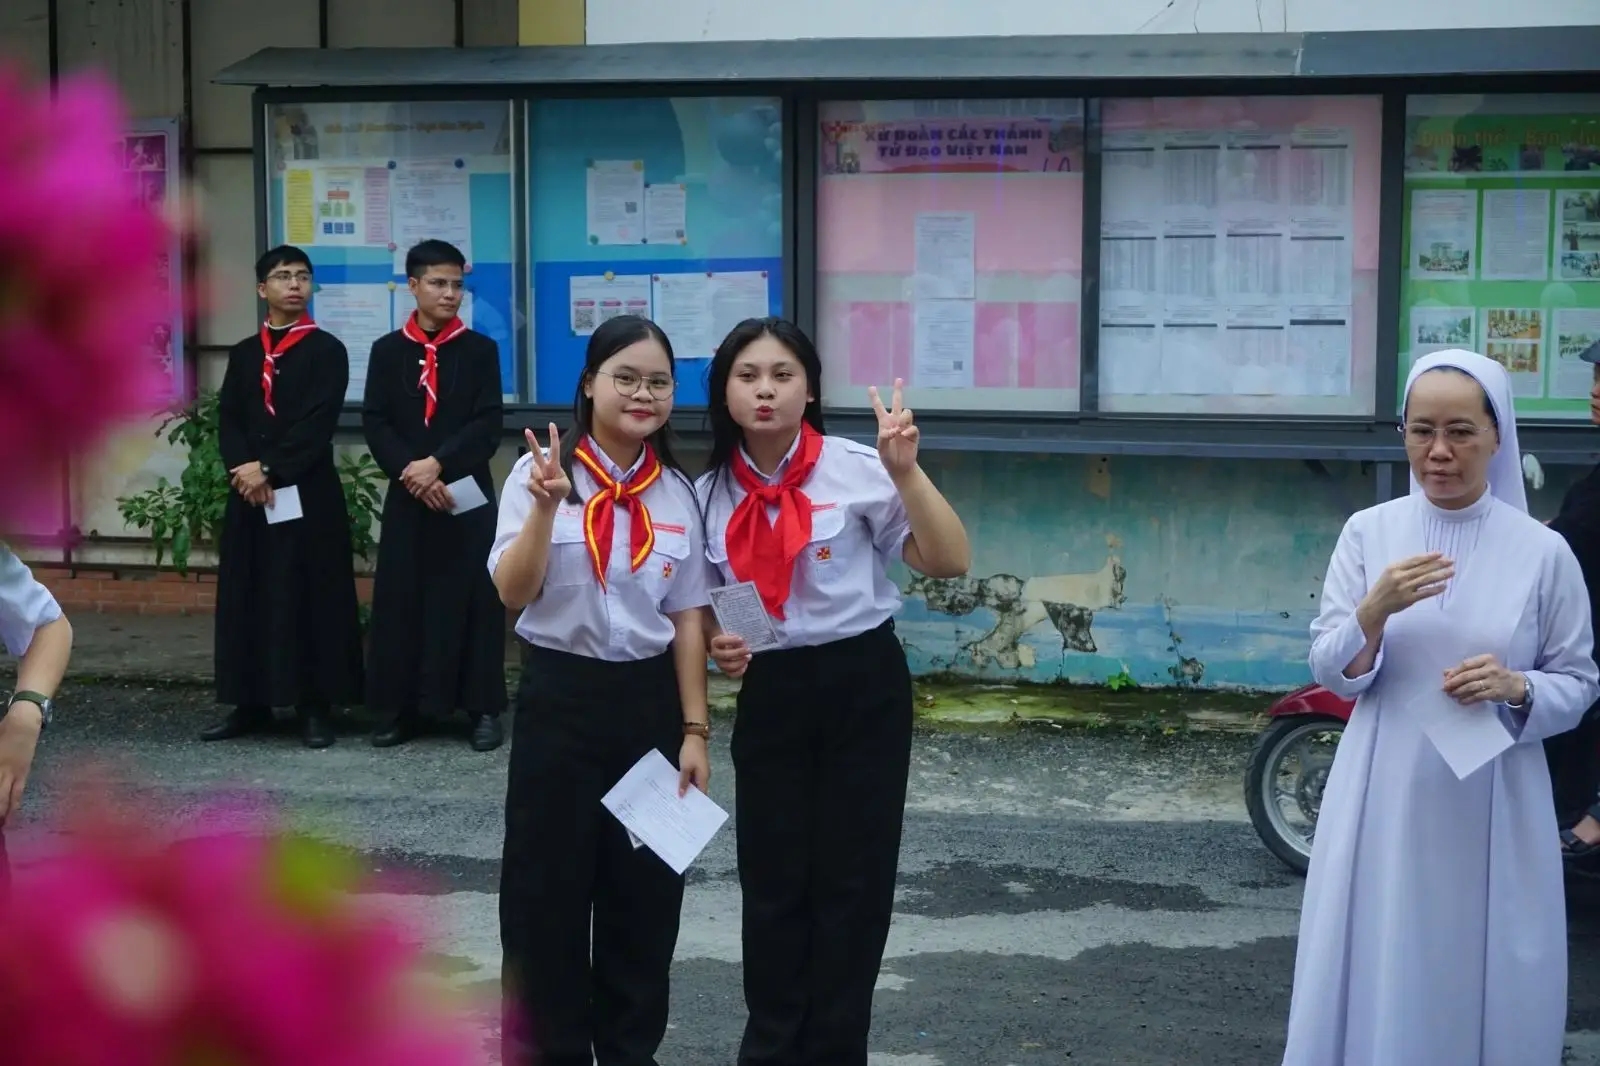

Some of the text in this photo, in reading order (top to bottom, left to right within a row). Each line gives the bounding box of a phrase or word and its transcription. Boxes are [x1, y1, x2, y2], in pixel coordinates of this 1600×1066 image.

[947, 123, 978, 141] CÁC
[982, 122, 1042, 140] THÁNH
[946, 143, 985, 160] VIỆT
[989, 144, 1028, 156] NAM
